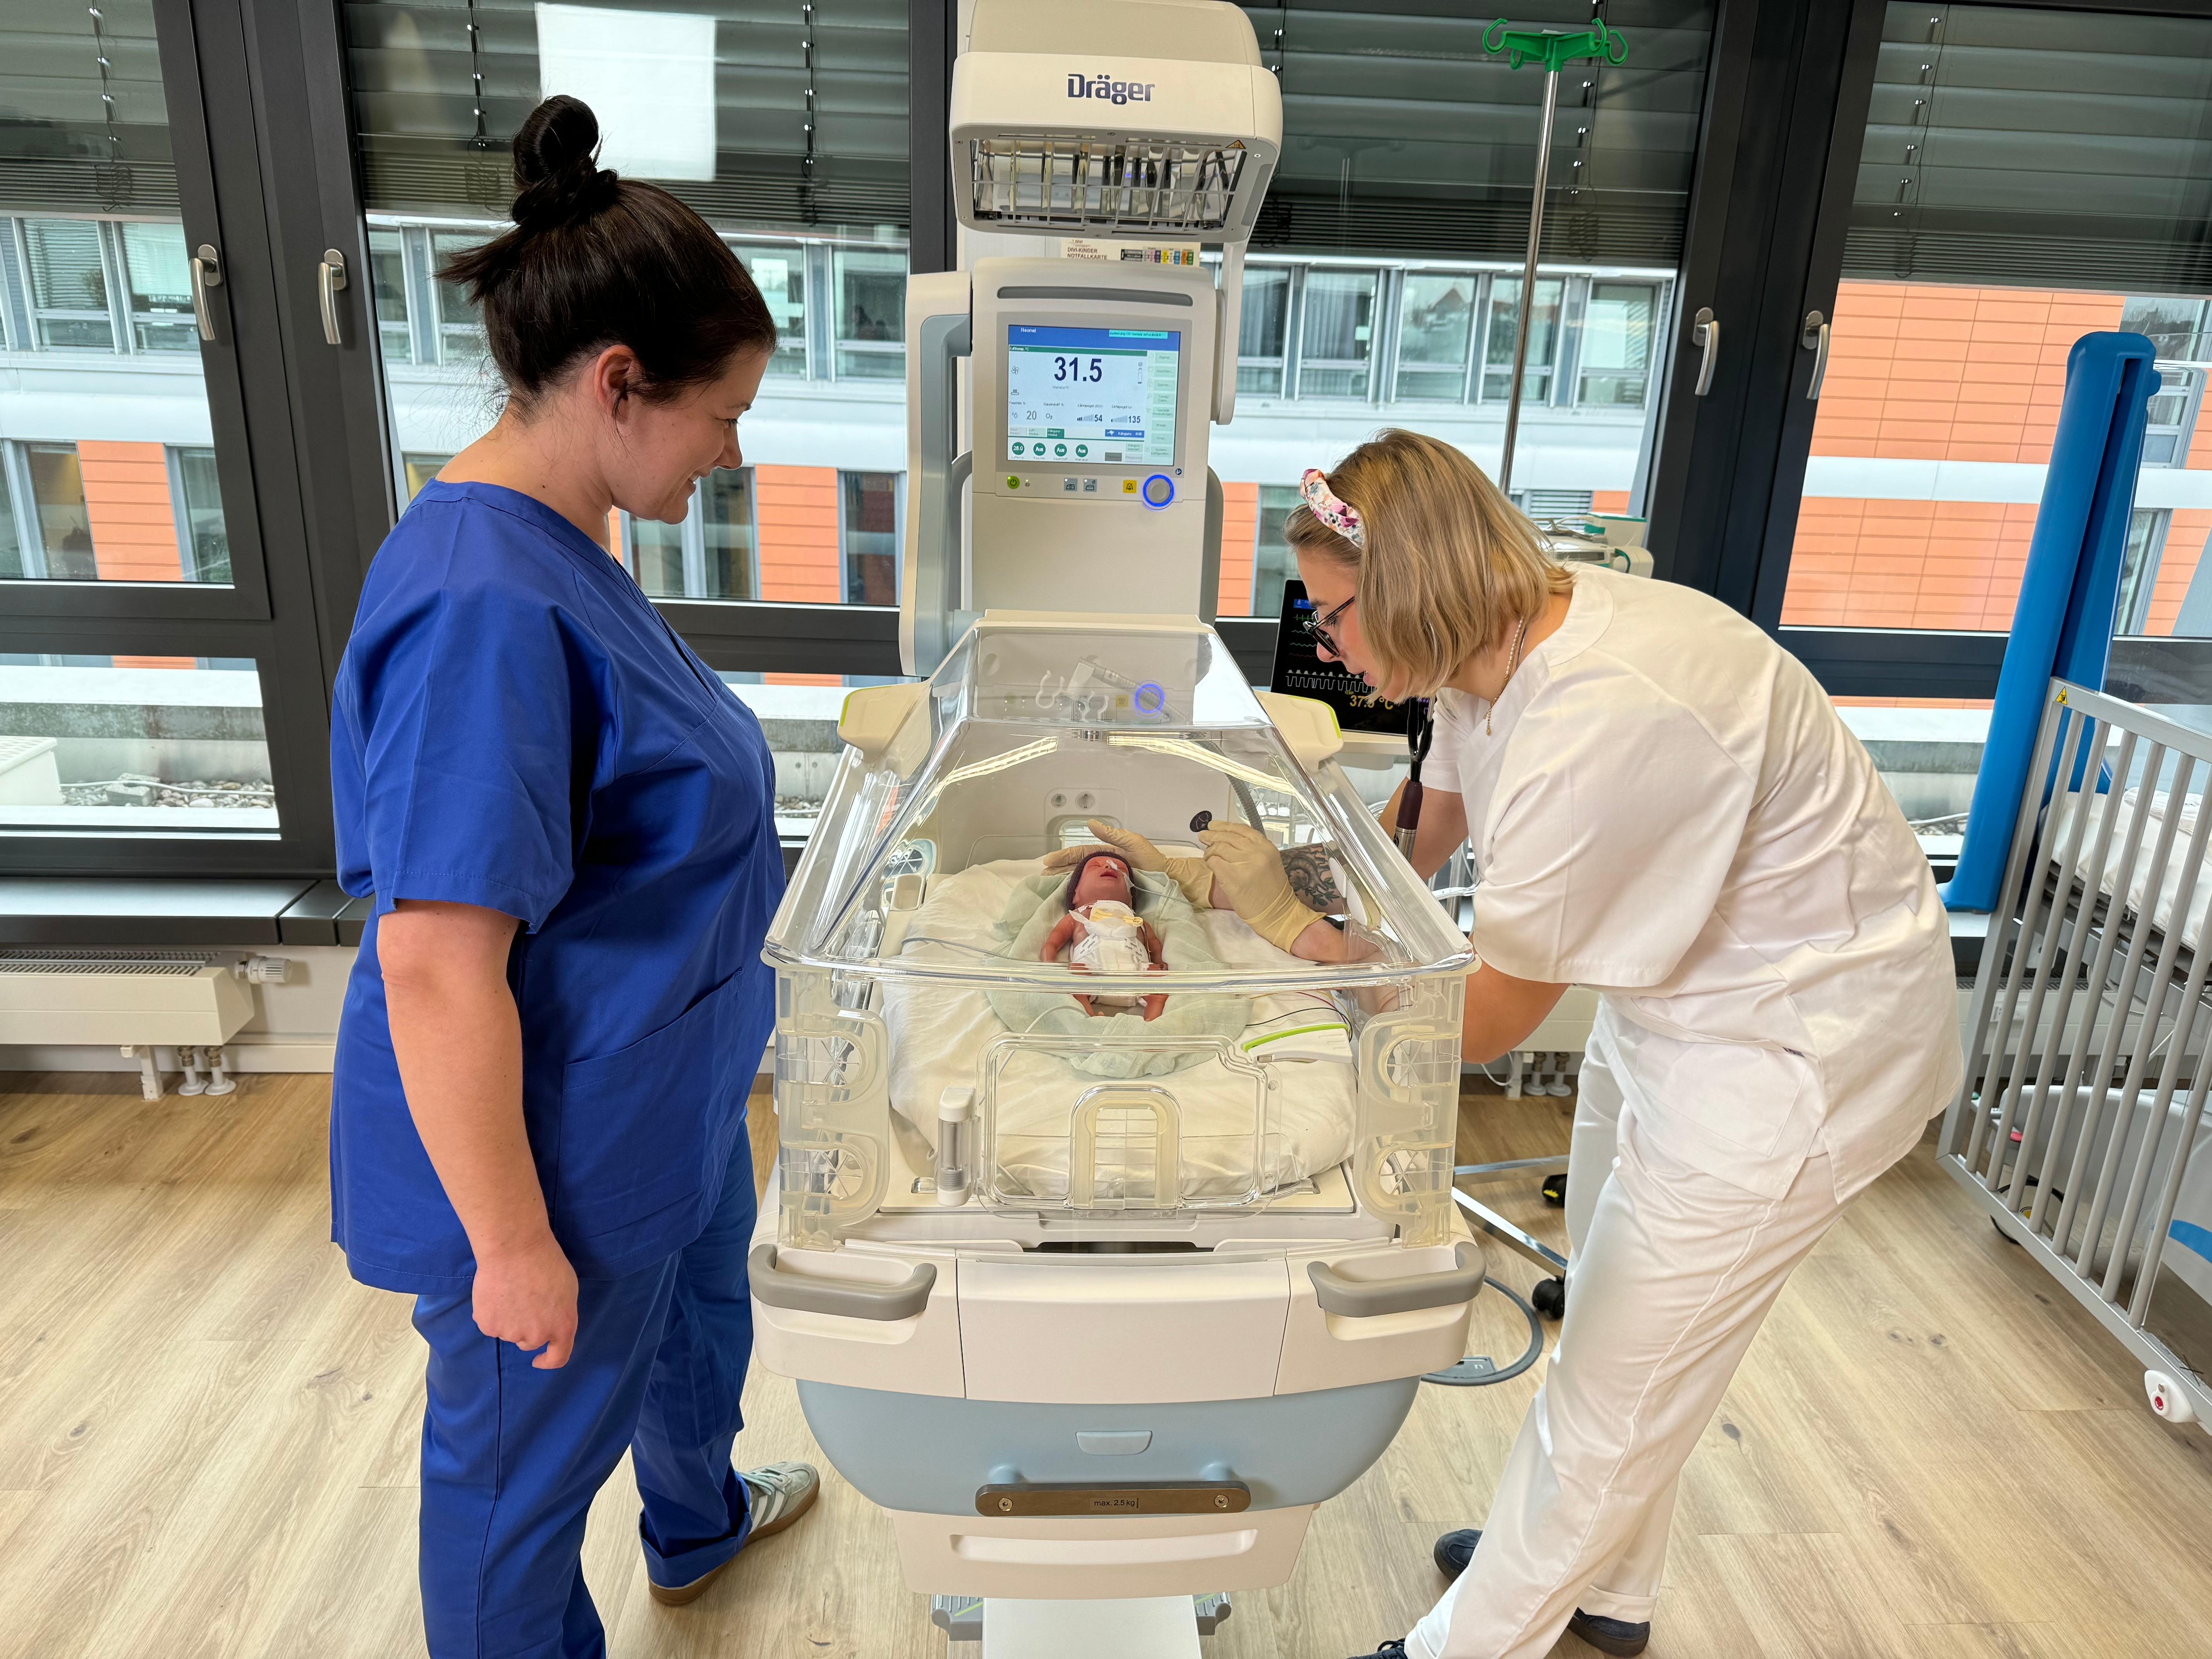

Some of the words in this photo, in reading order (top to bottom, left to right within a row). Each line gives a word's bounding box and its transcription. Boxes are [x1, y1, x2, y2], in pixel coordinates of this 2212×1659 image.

[1068, 74, 1155, 105] Dräger
[1054, 357, 1102, 382] 31.5
[1026, 410, 1037, 420] 20
